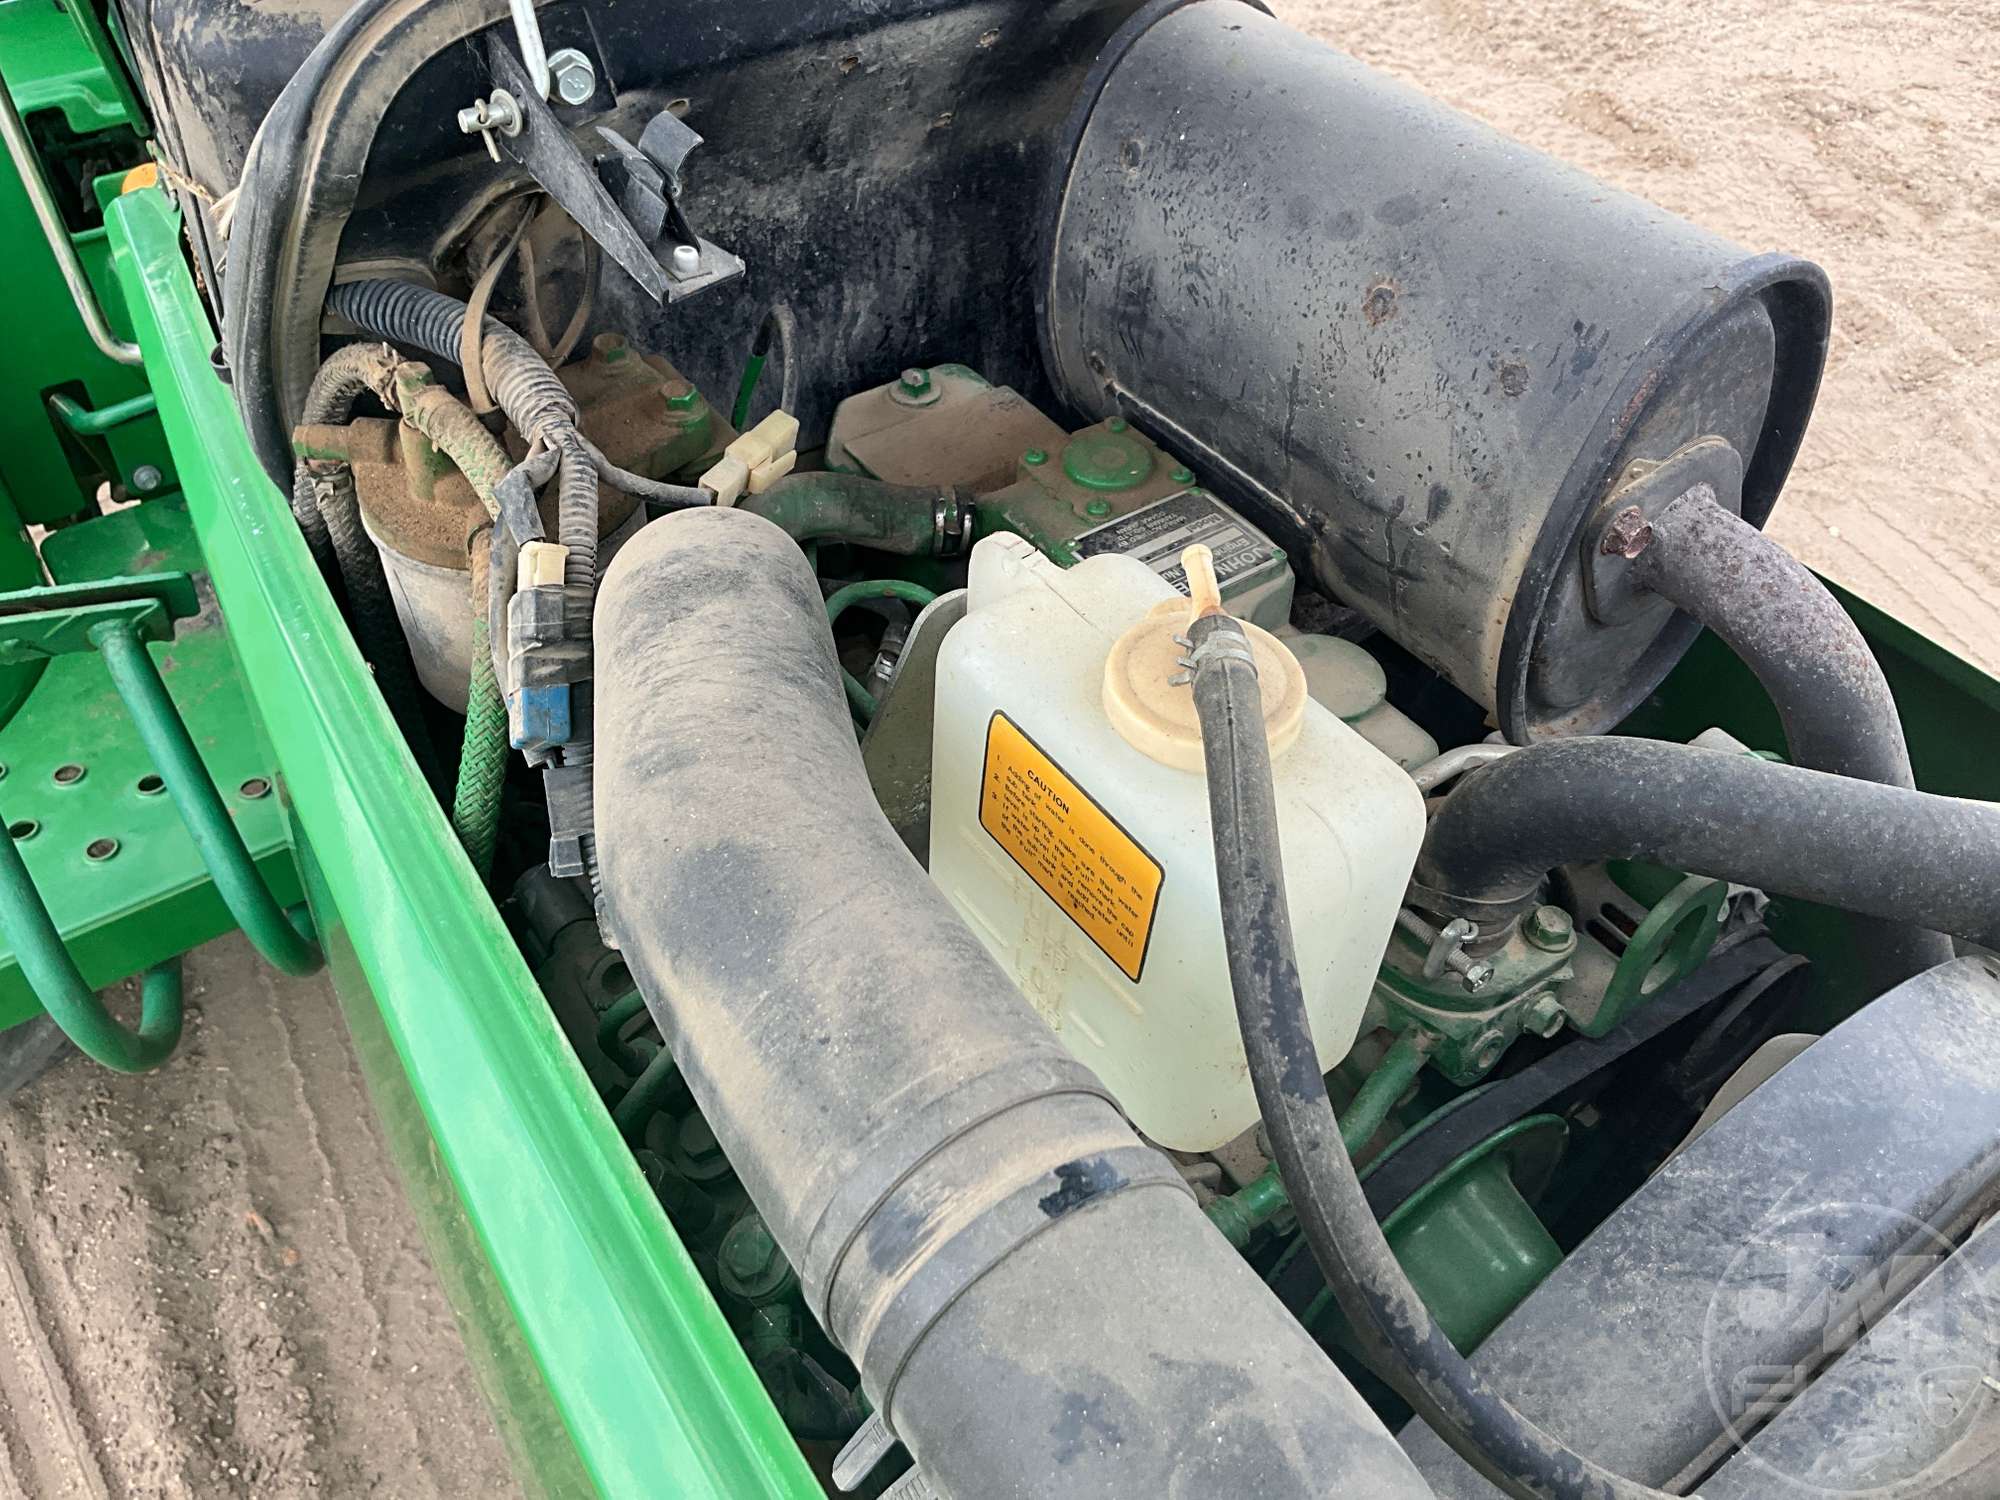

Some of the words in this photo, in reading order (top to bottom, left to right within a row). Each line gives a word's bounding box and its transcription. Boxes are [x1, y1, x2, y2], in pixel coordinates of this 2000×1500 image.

[1188, 513, 1221, 533] Model
[1211, 537, 1249, 556] Engine
[1215, 547, 1265, 575] JOHN
[1027, 770, 1069, 814] CAUTION
[1001, 821, 1011, 835] the
[1037, 860, 1054, 879] mark
[1003, 793, 1020, 812] level
[1054, 844, 1065, 858] the
[1004, 783, 1026, 807] Before
[1058, 839, 1077, 859] make
[1081, 861, 1095, 877] sure
[1099, 877, 1114, 895] that
[1118, 897, 1139, 918] water
[1033, 792, 1042, 801] of
[1045, 803, 1065, 824] water
[1078, 836, 1095, 855] done
[1099, 855, 1127, 885] through
[1131, 886, 1143, 901] the
[1011, 813, 1030, 832] water
[1033, 833, 1049, 853] level
[1077, 879, 1103, 907] remove
[1106, 907, 1118, 921] the
[1120, 922, 1134, 937] cap
[1012, 823, 1023, 837] the
[1026, 839, 1038, 853] sub
[1042, 854, 1056, 870] tank
[1060, 873, 1074, 888] and
[1075, 888, 1089, 904] add
[1092, 904, 1112, 925] water
[1116, 929, 1134, 948] until
